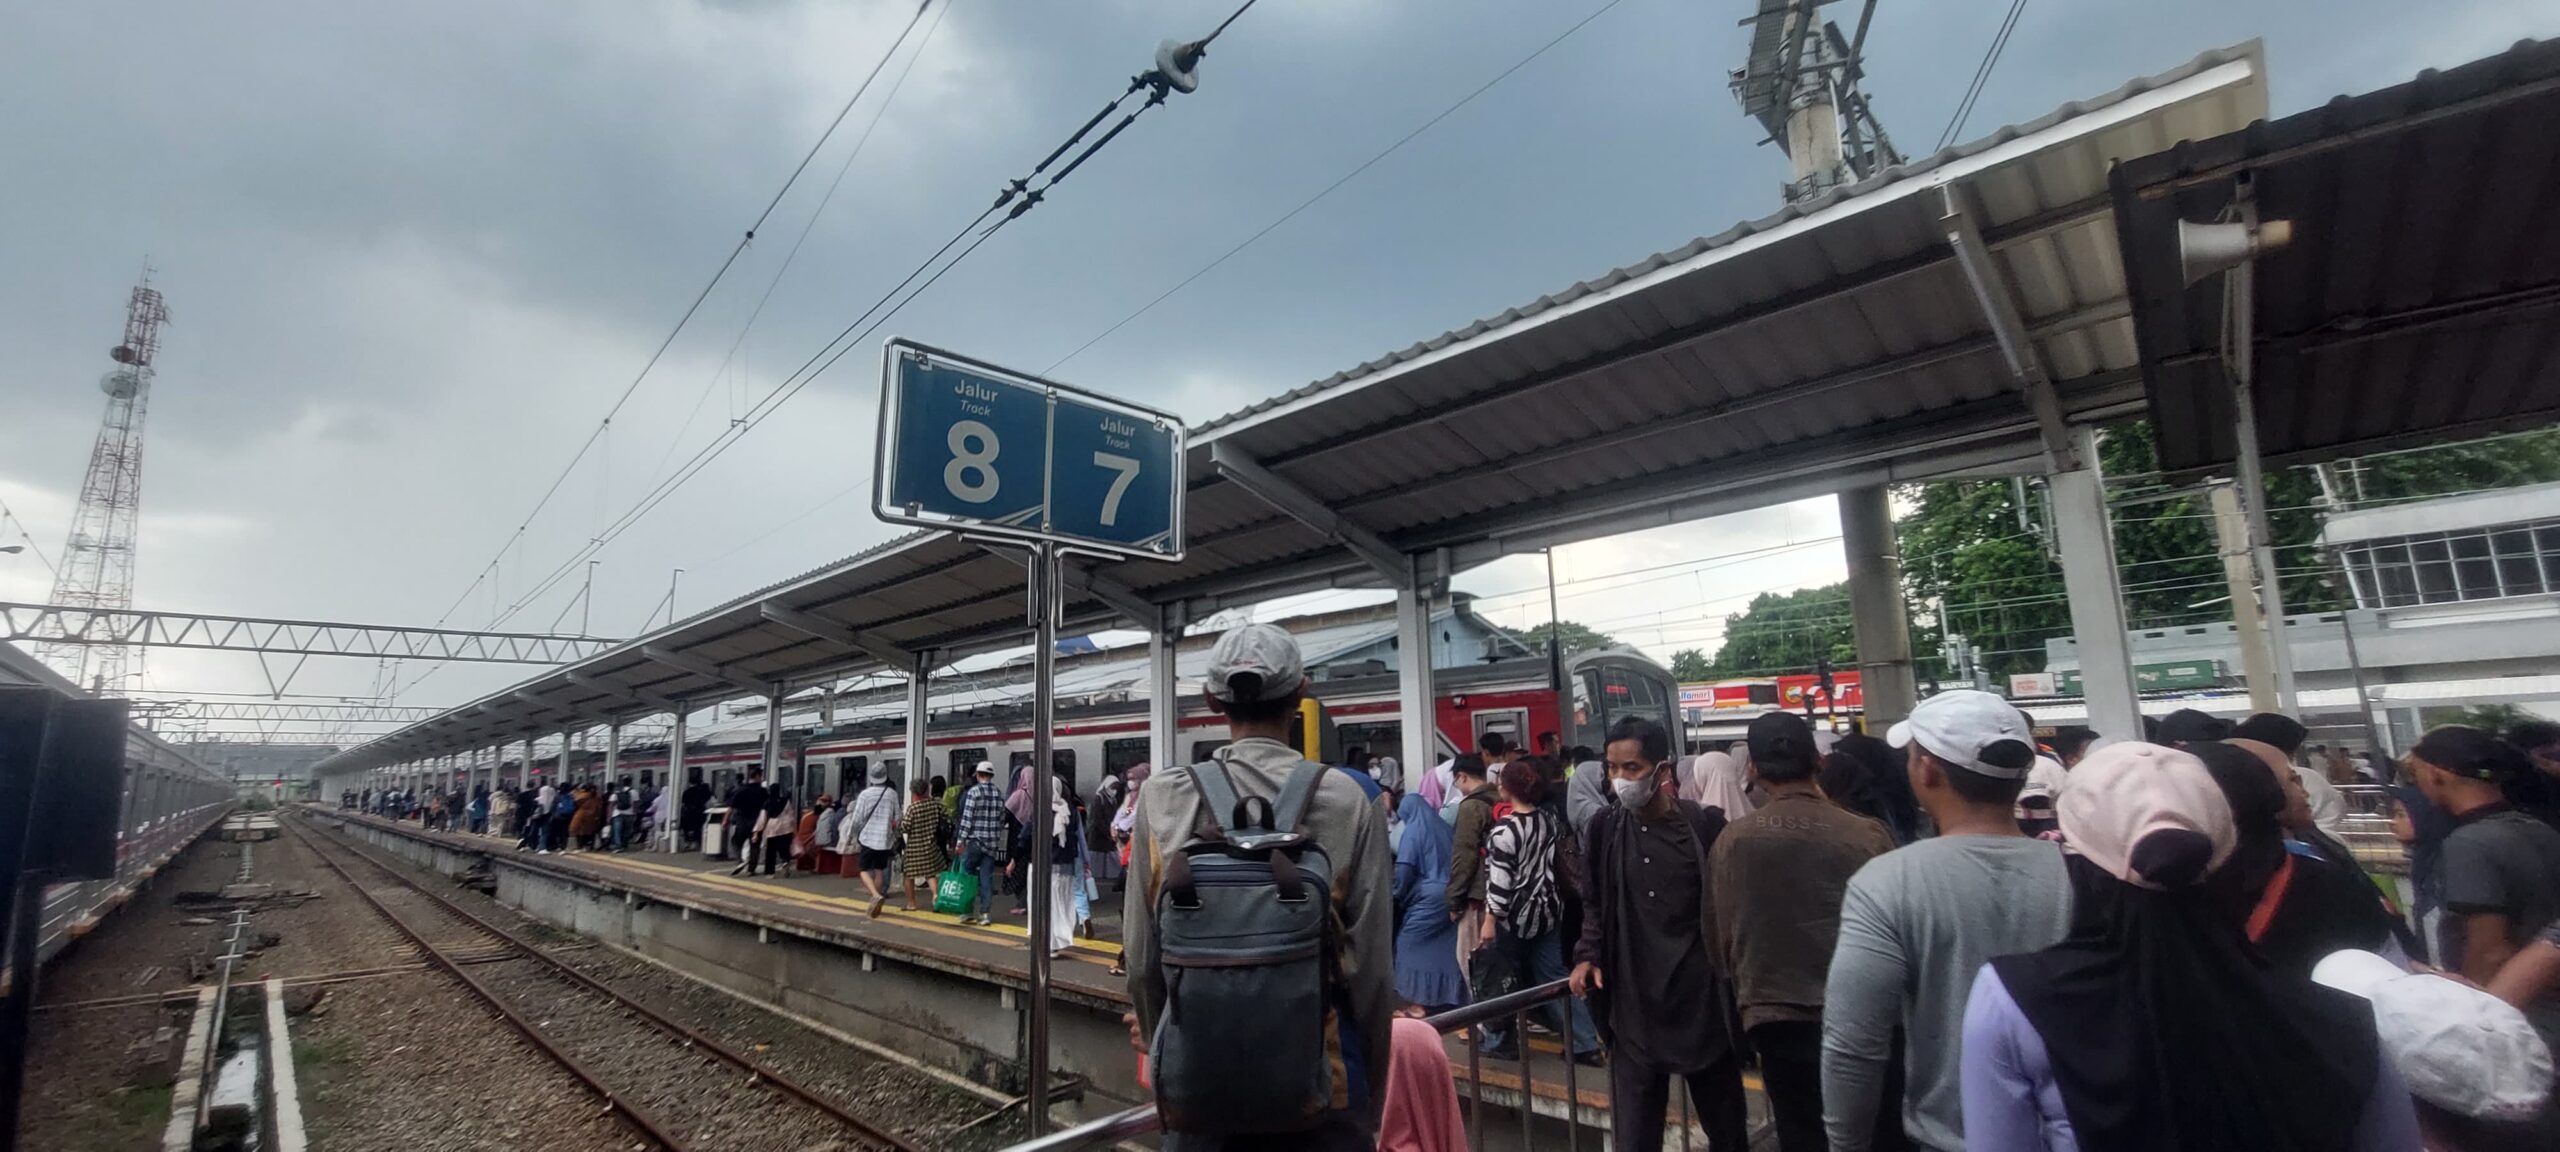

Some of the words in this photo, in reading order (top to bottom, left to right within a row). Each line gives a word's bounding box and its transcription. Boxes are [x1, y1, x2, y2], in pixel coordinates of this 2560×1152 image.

[954, 379, 998, 402] Jalur
[960, 399, 991, 416] Track
[1099, 416, 1136, 437] Jalur
[1105, 434, 1131, 450] Track
[943, 420, 1000, 503] 8
[1093, 450, 1140, 526] 7
[1679, 687, 1711, 699] lfamart
